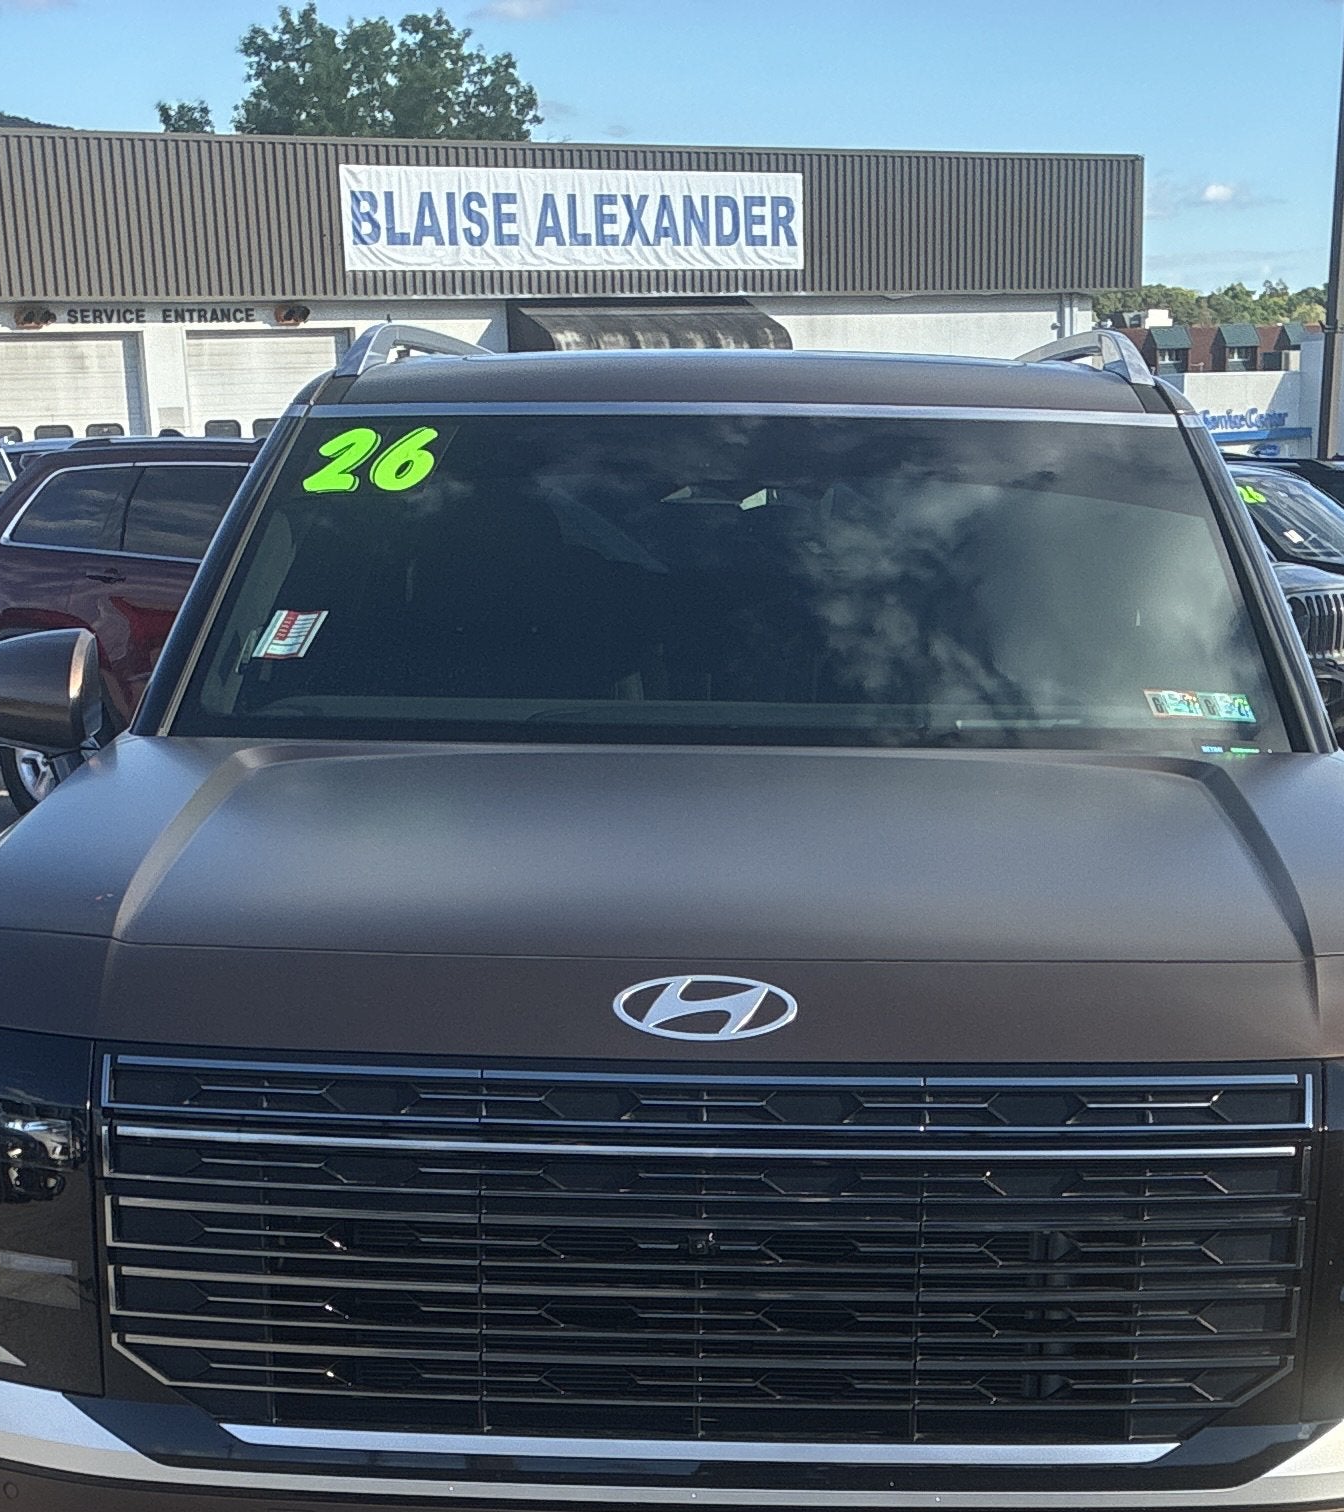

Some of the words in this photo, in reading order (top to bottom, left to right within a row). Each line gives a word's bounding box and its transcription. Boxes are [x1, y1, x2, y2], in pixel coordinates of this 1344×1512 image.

[349, 189, 520, 247] BLAISE
[534, 192, 798, 247] ALEXANDER
[66, 308, 146, 324] SERVICE
[162, 307, 256, 324] ENTRANCE
[302, 426, 439, 493] 26
